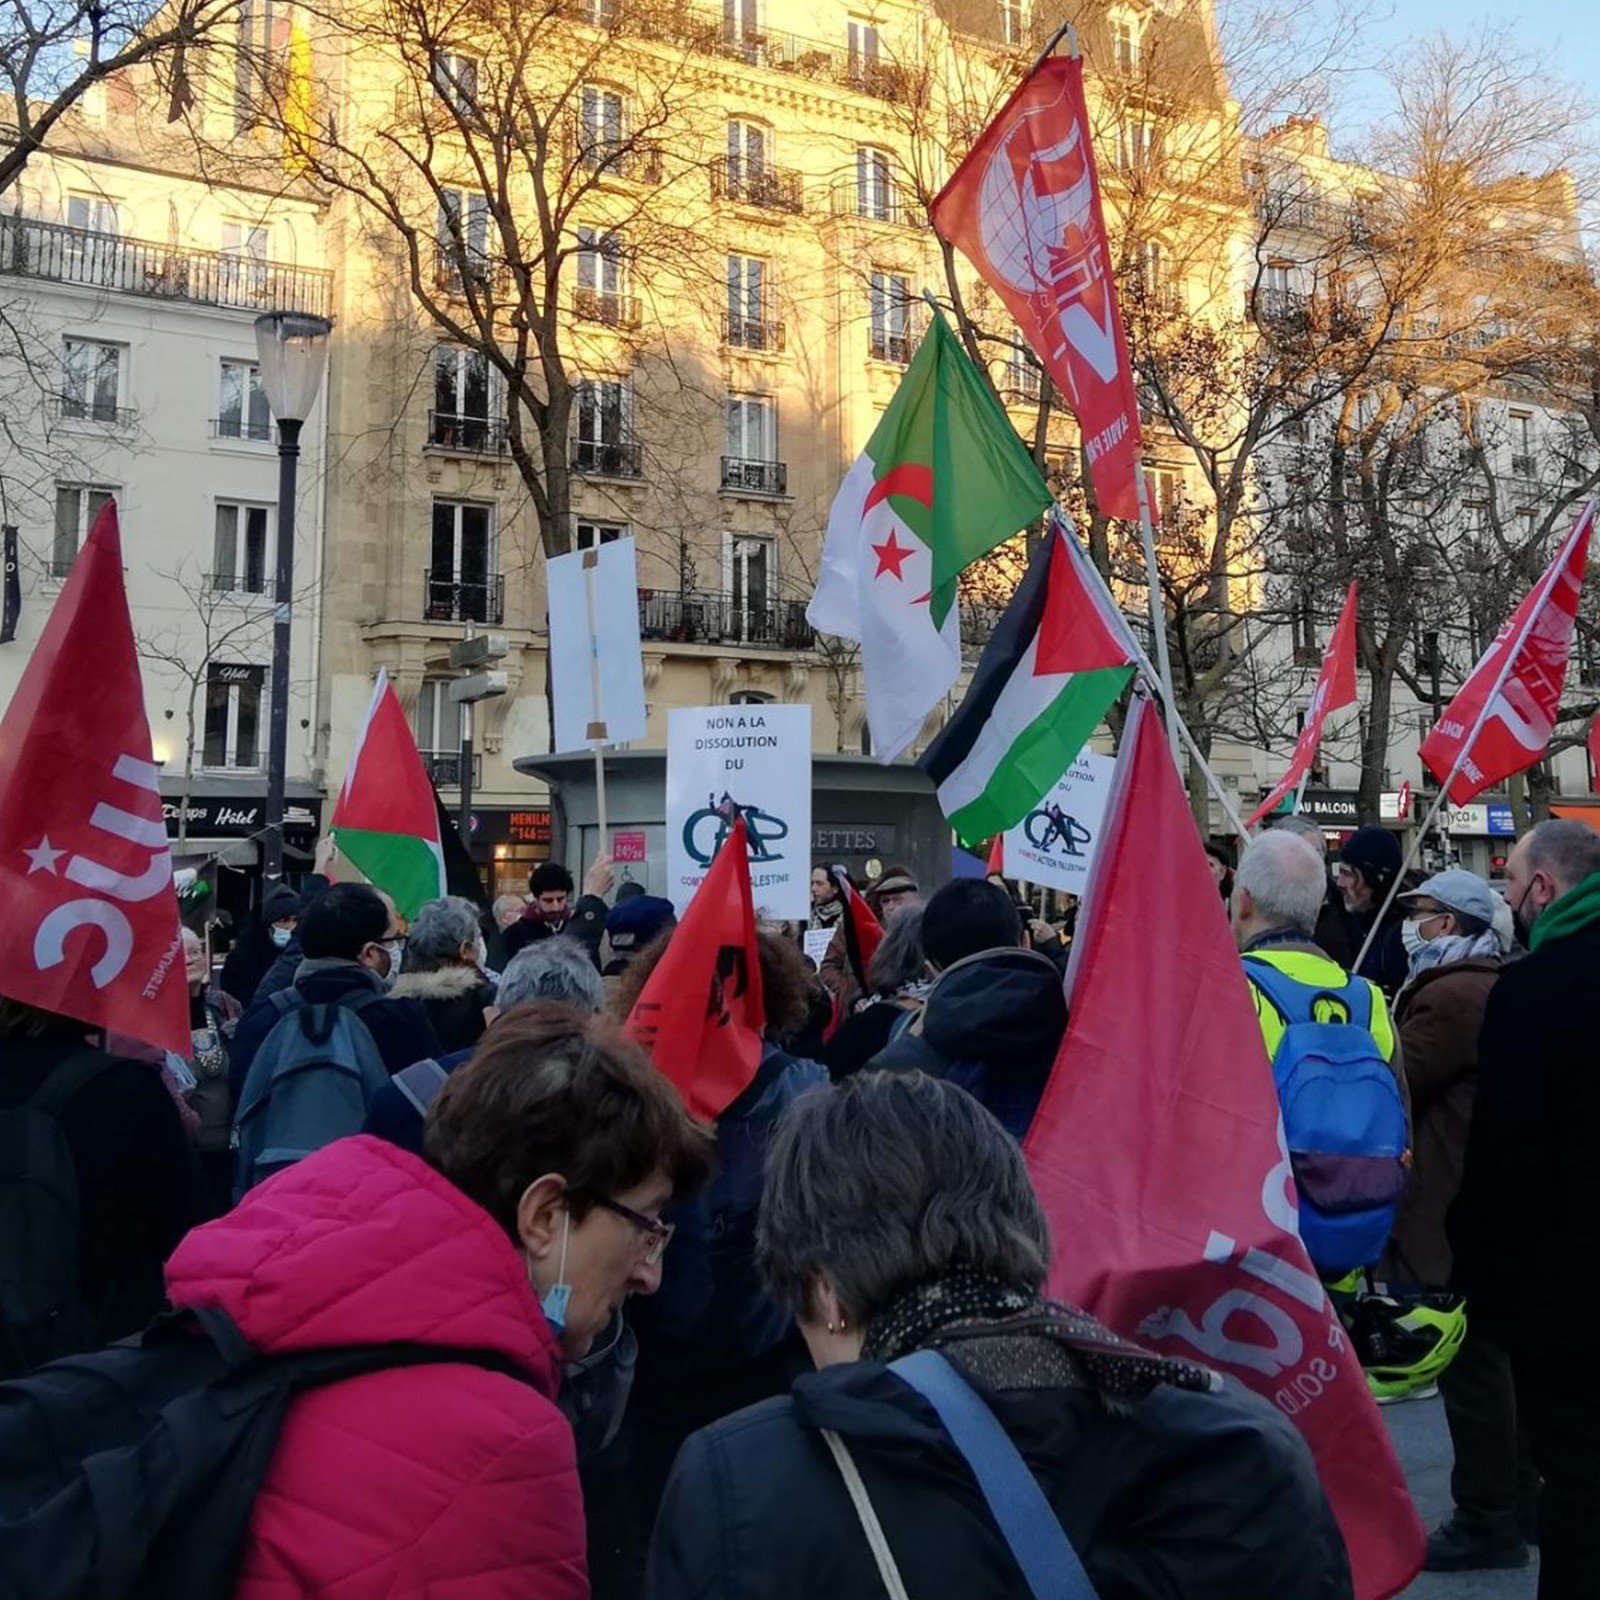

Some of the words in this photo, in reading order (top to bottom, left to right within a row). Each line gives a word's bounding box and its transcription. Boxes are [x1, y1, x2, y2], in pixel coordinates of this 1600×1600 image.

[706, 717, 734, 731] NON
[737, 716, 747, 728] A
[750, 715, 766, 728] LA
[695, 735, 778, 751] DISSOLUTION
[725, 758, 744, 771] DU
[1058, 782, 1072, 792] DU
[214, 806, 258, 825] Hôtel
[1300, 802, 1312, 813] AU
[1315, 802, 1356, 814] BALCON
[812, 830, 876, 850] ETTES
